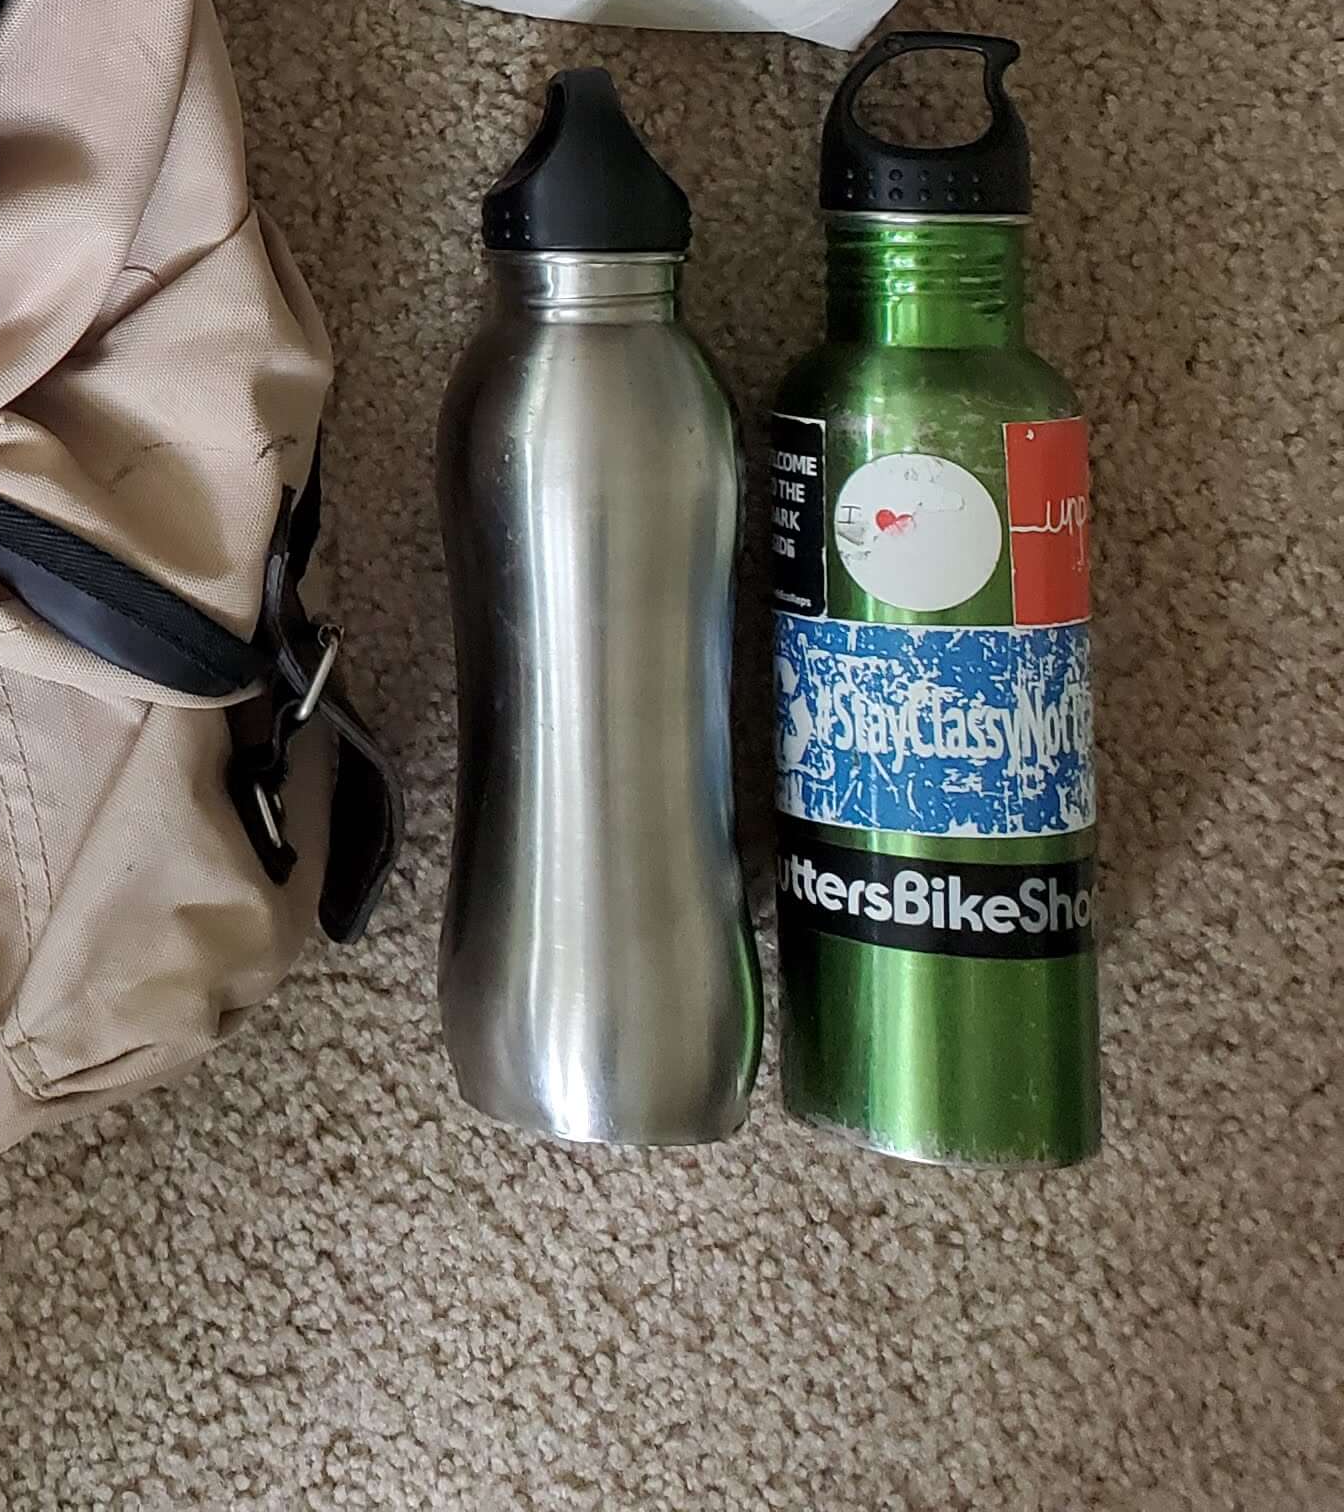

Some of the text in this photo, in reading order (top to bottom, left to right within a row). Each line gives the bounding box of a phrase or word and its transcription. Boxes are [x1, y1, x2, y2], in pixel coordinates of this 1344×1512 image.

[778, 479, 806, 504] THE
[773, 506, 801, 532] ARK
[778, 853, 1097, 934] uttersBikeSho
